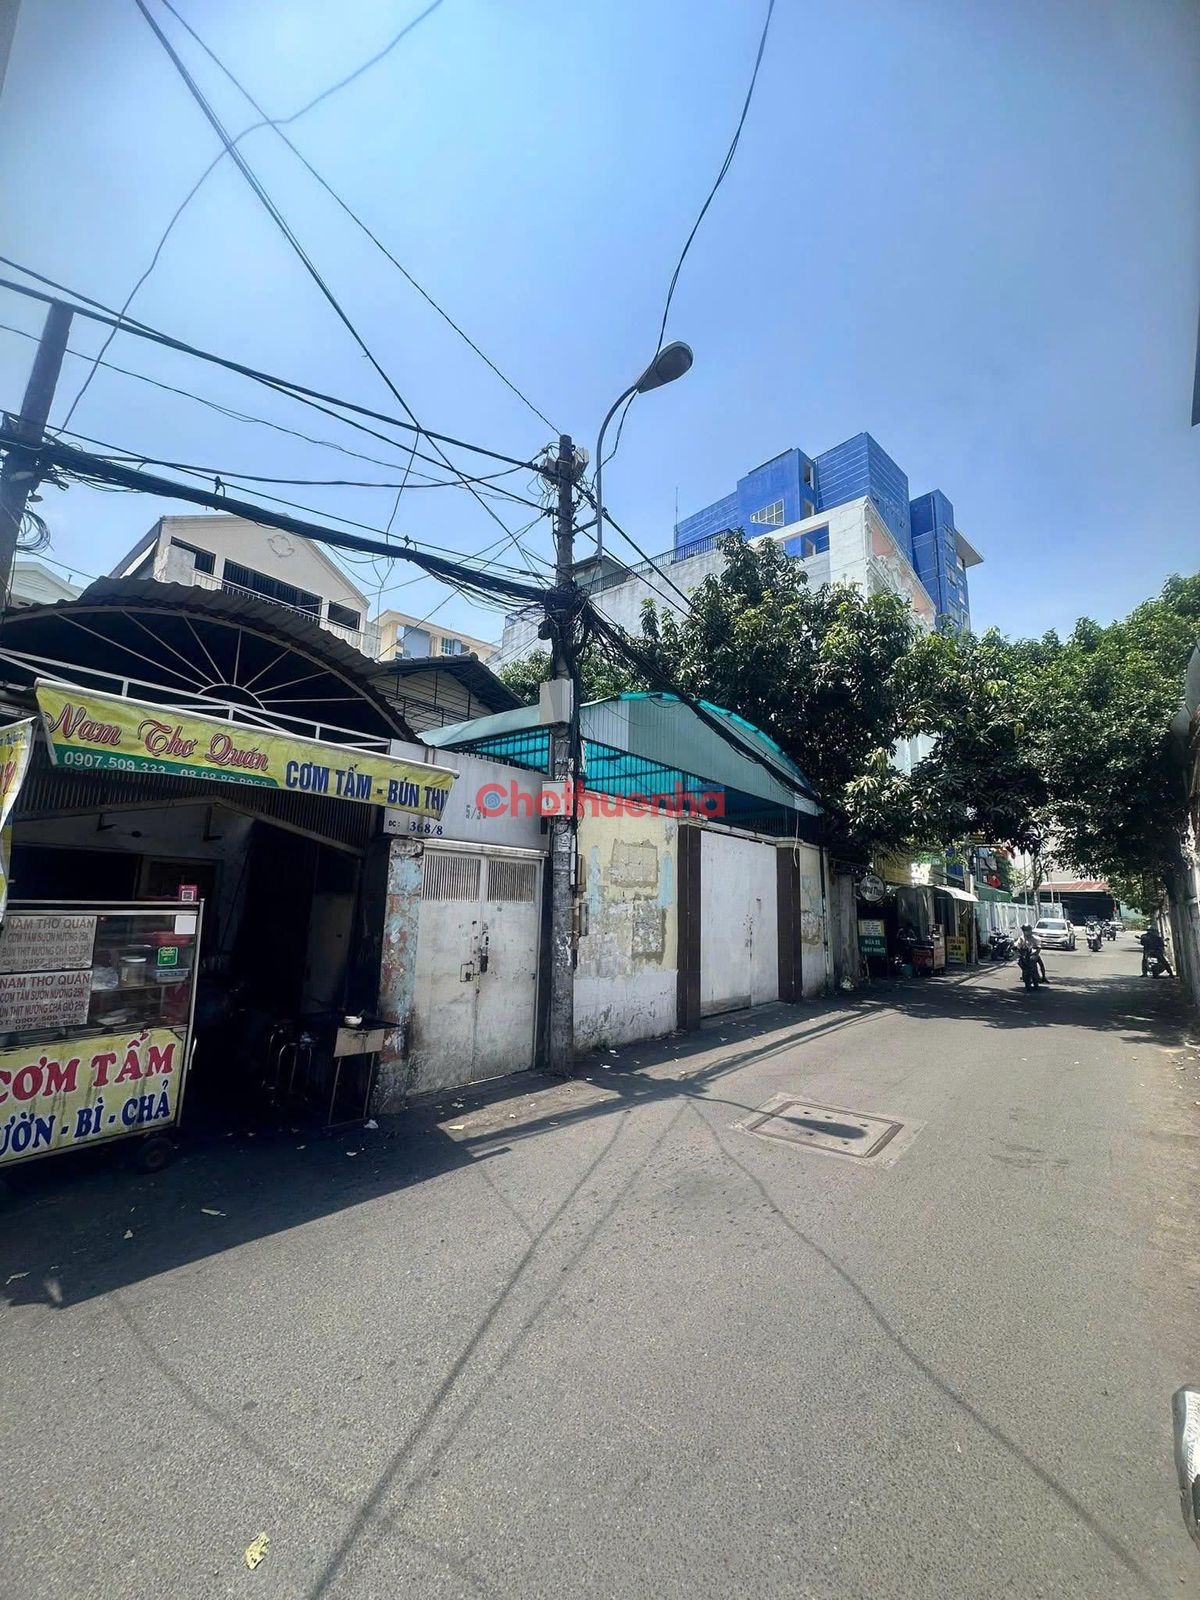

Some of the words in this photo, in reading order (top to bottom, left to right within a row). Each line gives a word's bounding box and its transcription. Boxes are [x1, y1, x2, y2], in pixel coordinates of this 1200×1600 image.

[44, 703, 121, 745] Nam
[138, 718, 198, 758] Thơ
[204, 732, 269, 771] Quán
[285, 760, 330, 794] CƠM
[335, 763, 373, 800] TẤM
[387, 776, 420, 808] BÚN
[409, 821, 443, 836] 368/8
[90, 1029, 176, 1087] TẤM
[121, 1079, 170, 1126] CHẢ
